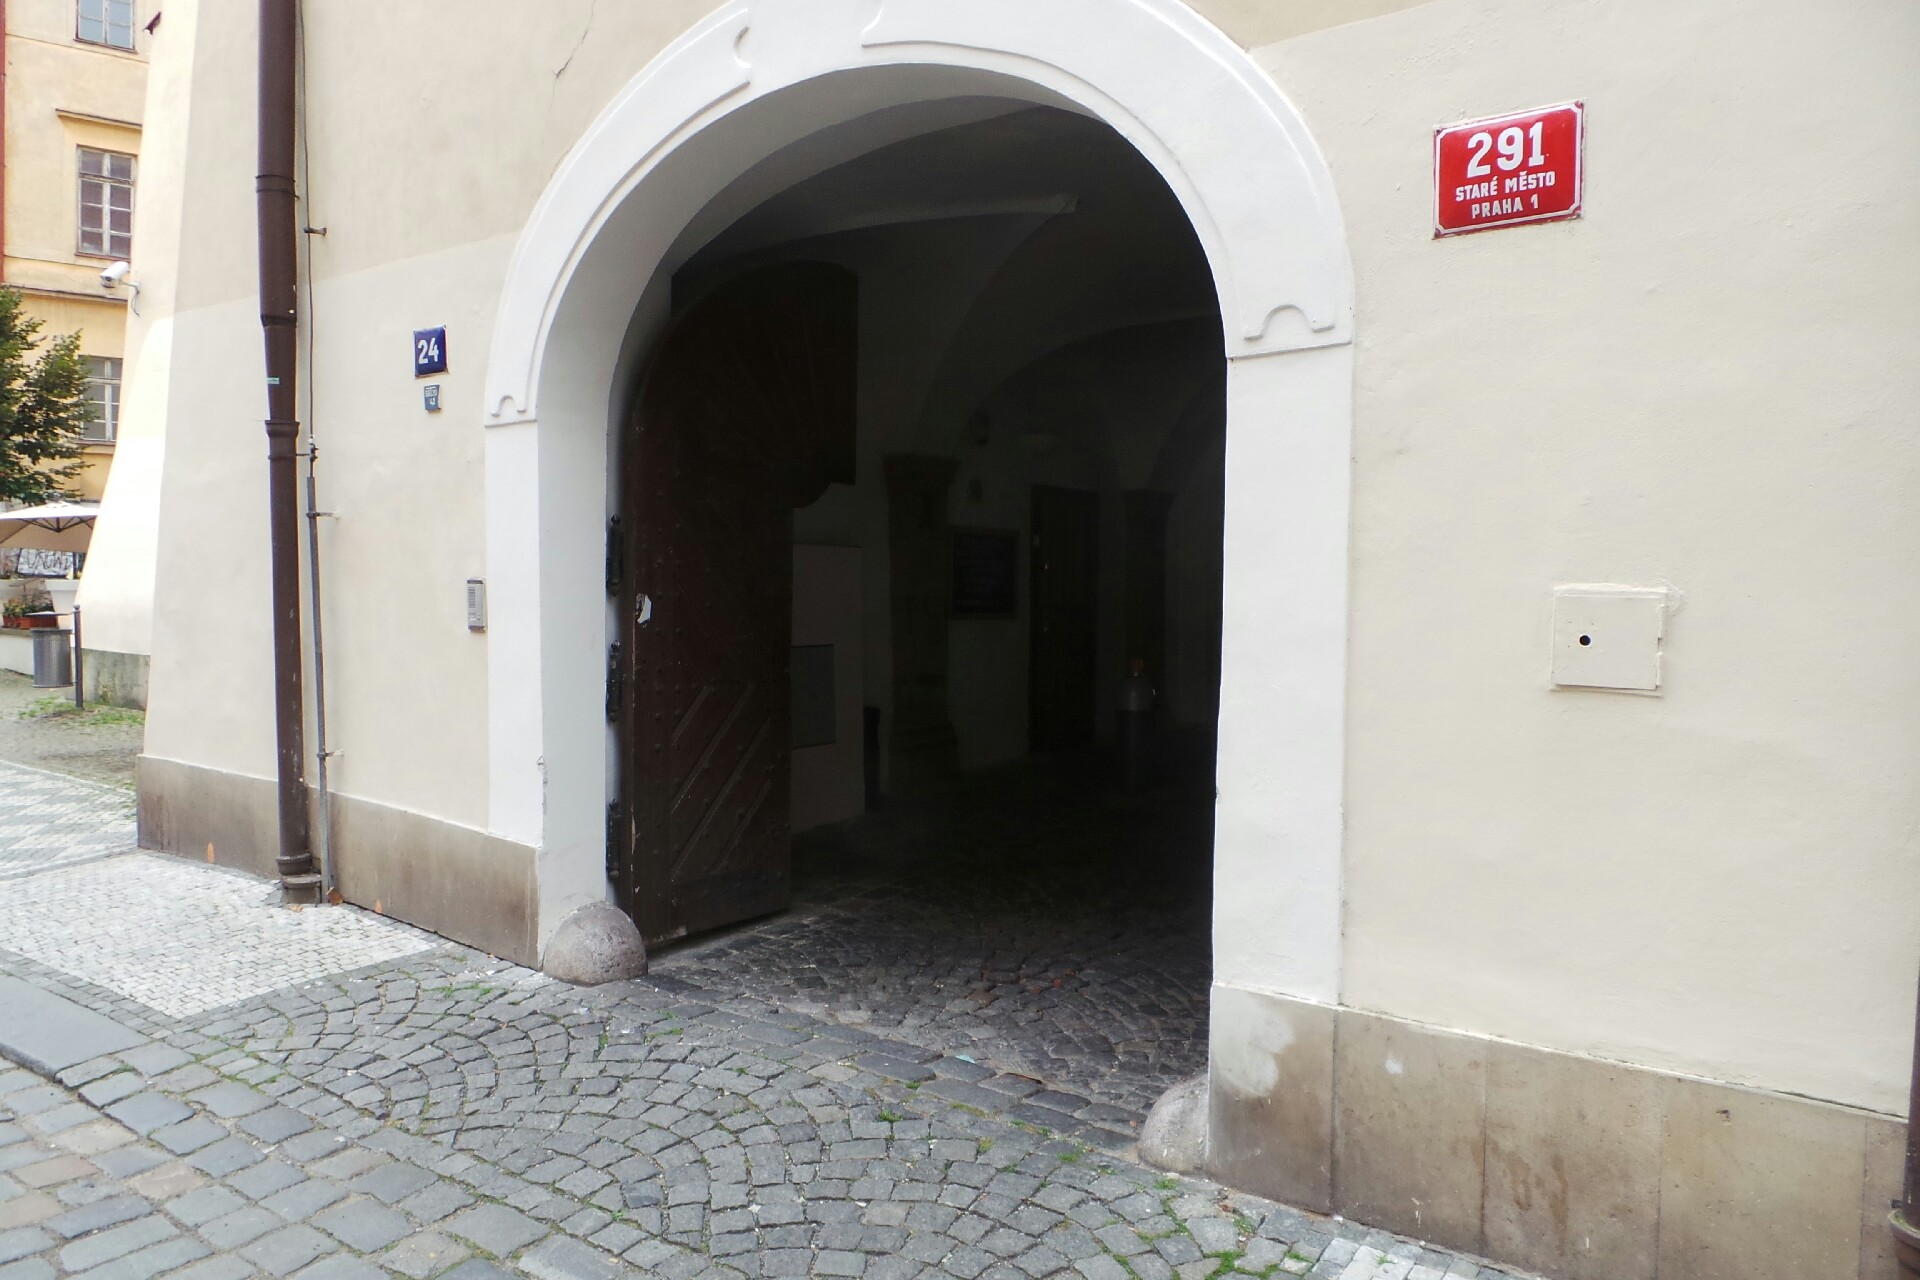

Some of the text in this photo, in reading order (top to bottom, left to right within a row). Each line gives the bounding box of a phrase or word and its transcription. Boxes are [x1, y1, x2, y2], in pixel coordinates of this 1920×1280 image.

[1467, 121, 1545, 178] 291
[1455, 171, 1556, 202] STARÉ MĚSTO
[1471, 193, 1539, 219] PRAHA 1
[417, 337, 439, 365] 24
